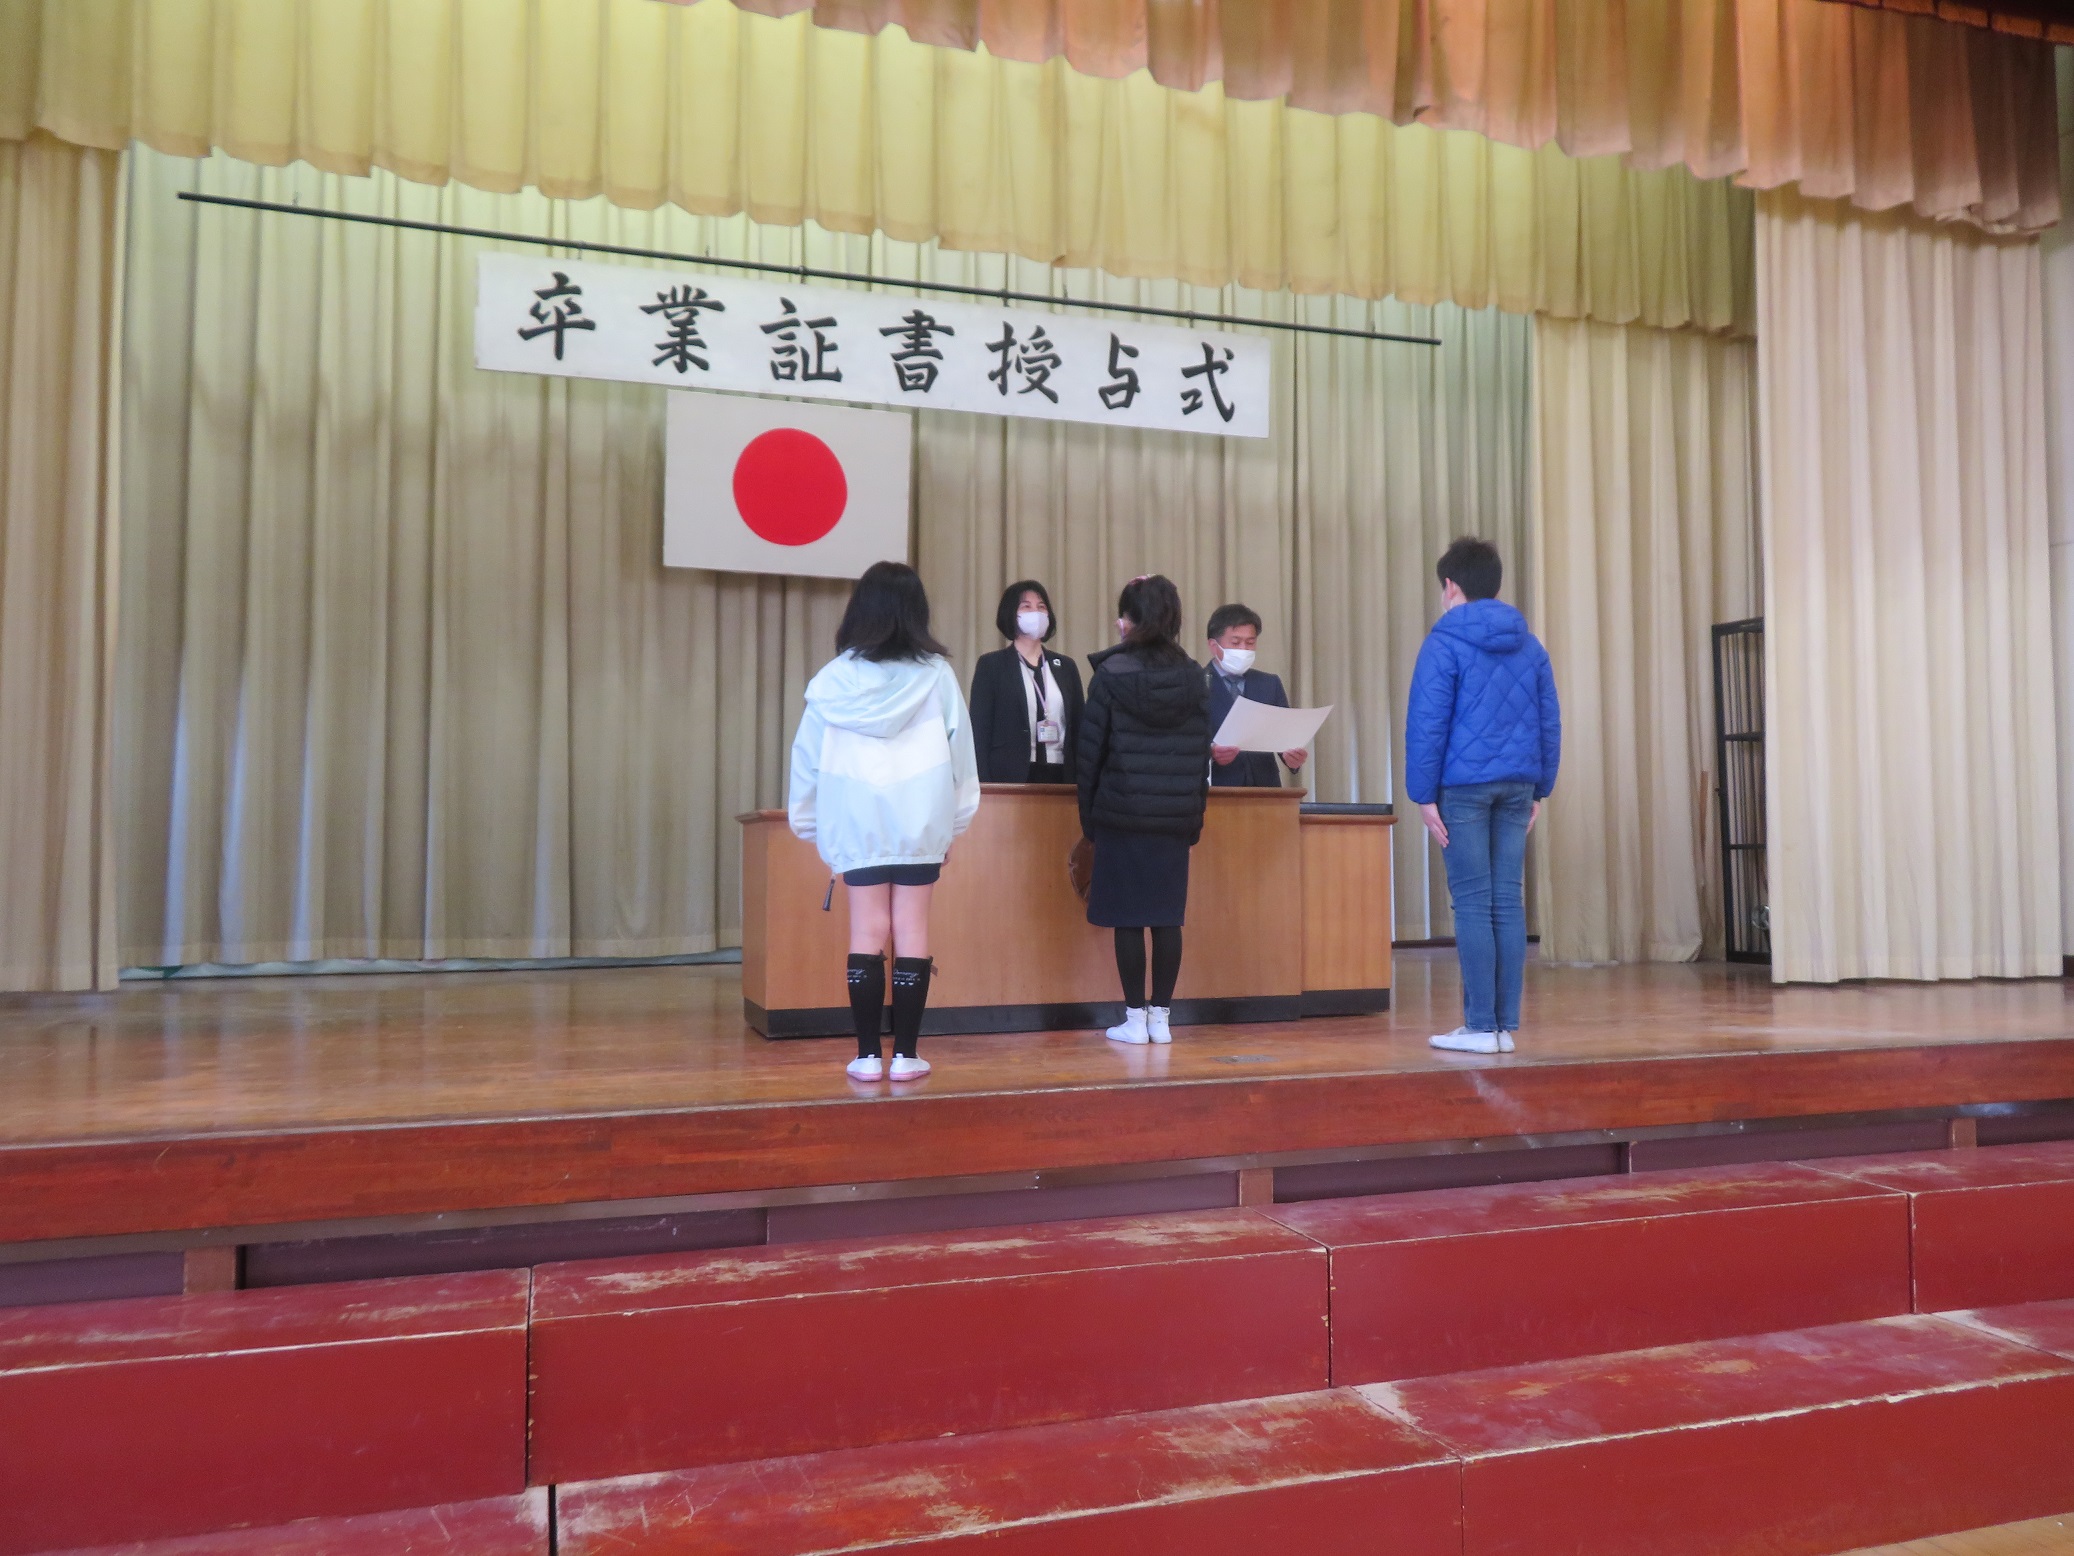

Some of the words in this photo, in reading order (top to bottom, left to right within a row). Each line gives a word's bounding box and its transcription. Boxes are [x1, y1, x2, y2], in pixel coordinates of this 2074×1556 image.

[518, 271, 1235, 423] 卒業証書授与式
